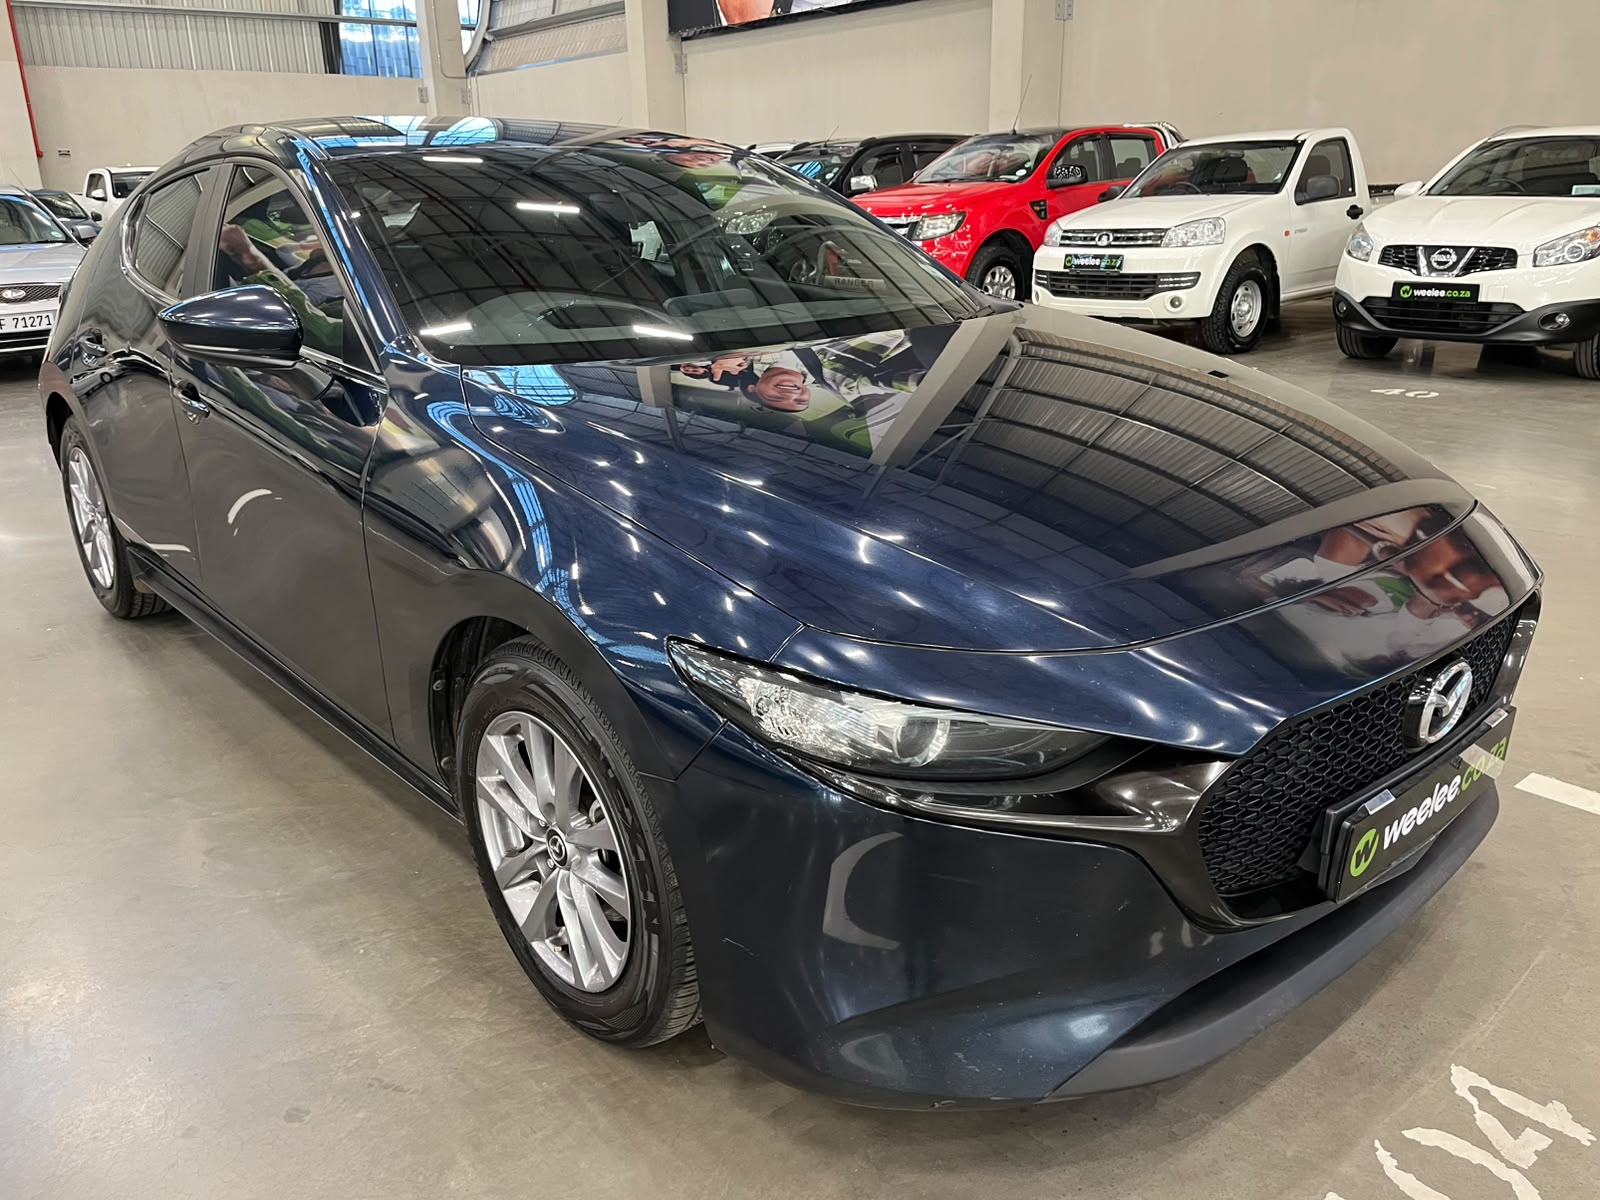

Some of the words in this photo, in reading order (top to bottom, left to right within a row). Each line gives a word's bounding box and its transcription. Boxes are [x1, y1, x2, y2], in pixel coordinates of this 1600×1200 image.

[1413, 287, 1471, 298] weelee.co.za
[12, 314, 52, 328] 71271
[1383, 736, 1507, 850] weelee.co.za
